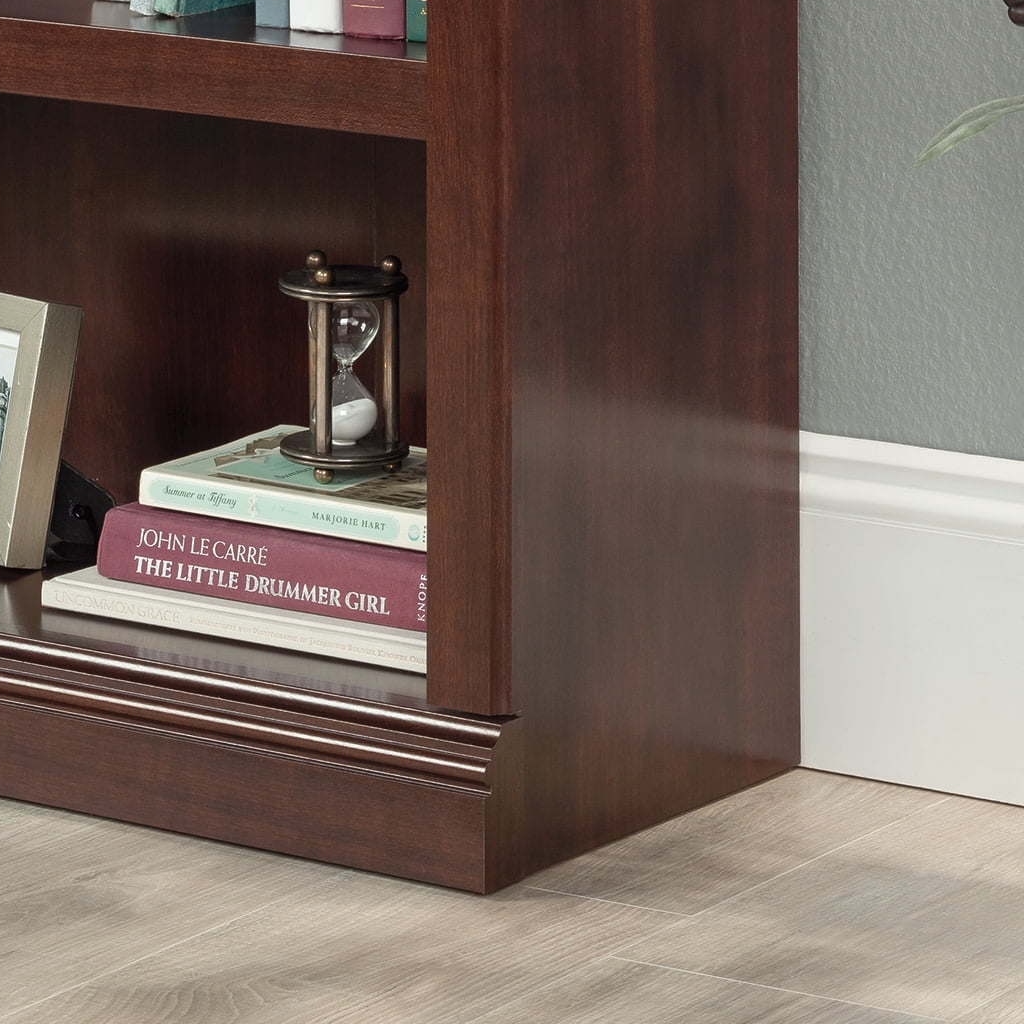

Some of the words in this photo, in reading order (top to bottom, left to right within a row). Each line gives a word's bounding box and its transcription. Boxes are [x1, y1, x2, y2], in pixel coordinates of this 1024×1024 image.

[163, 484, 195, 499] Summer
[196, 492, 206, 502] at
[208, 490, 238, 509] Tiffany
[311, 511, 359, 526] MARJORIE
[361, 519, 387, 531] HART
[136, 527, 186, 552] JOHN
[190, 536, 210, 557] LE
[212, 540, 268, 566] CARRÉ
[134, 555, 173, 579] THE
[176, 562, 239, 590] LITTLE
[244, 574, 342, 608] DRUMMER
[344, 591, 391, 616] GIRL
[417, 574, 428, 622] KNOPF
[54, 590, 135, 615] UNCOMMON
[137, 605, 180, 623] GRACE
